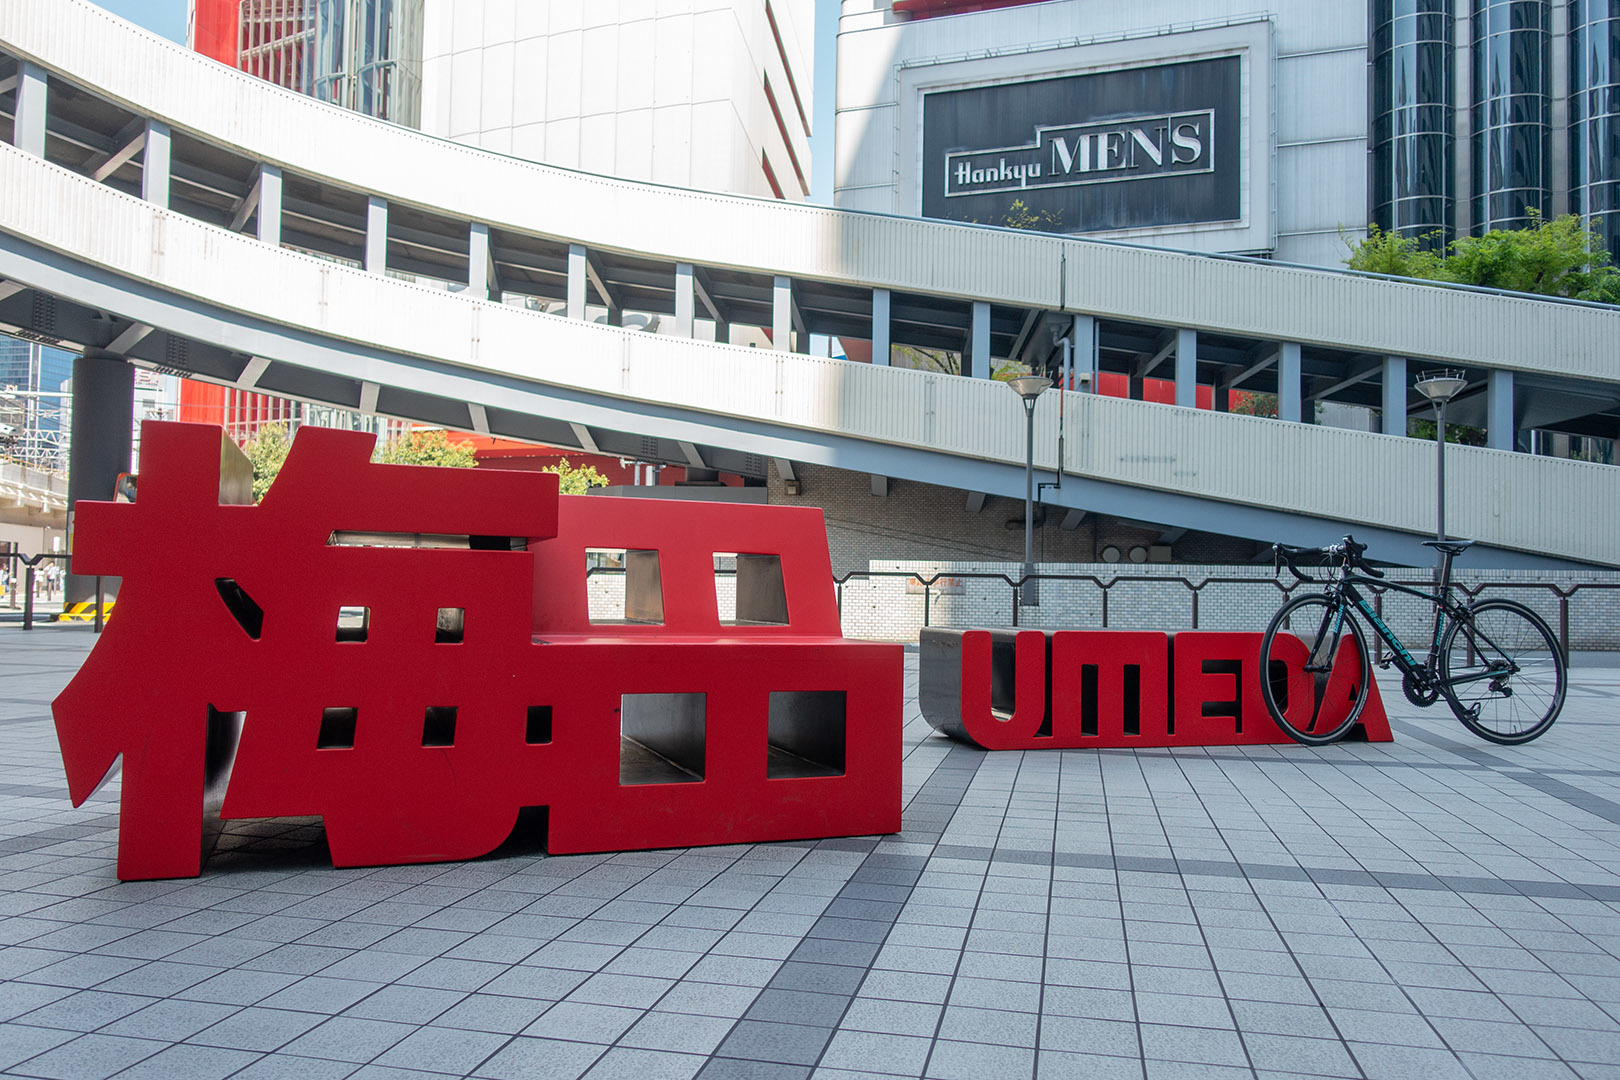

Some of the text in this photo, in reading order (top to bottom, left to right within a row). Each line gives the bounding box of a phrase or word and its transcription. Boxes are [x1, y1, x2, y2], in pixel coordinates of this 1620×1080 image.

[954, 158, 1042, 188] Hankyu
[52, 420, 904, 882] 梅田
[1359, 600, 1417, 666] Bianchi
[961, 630, 1394, 750] UMEDA
